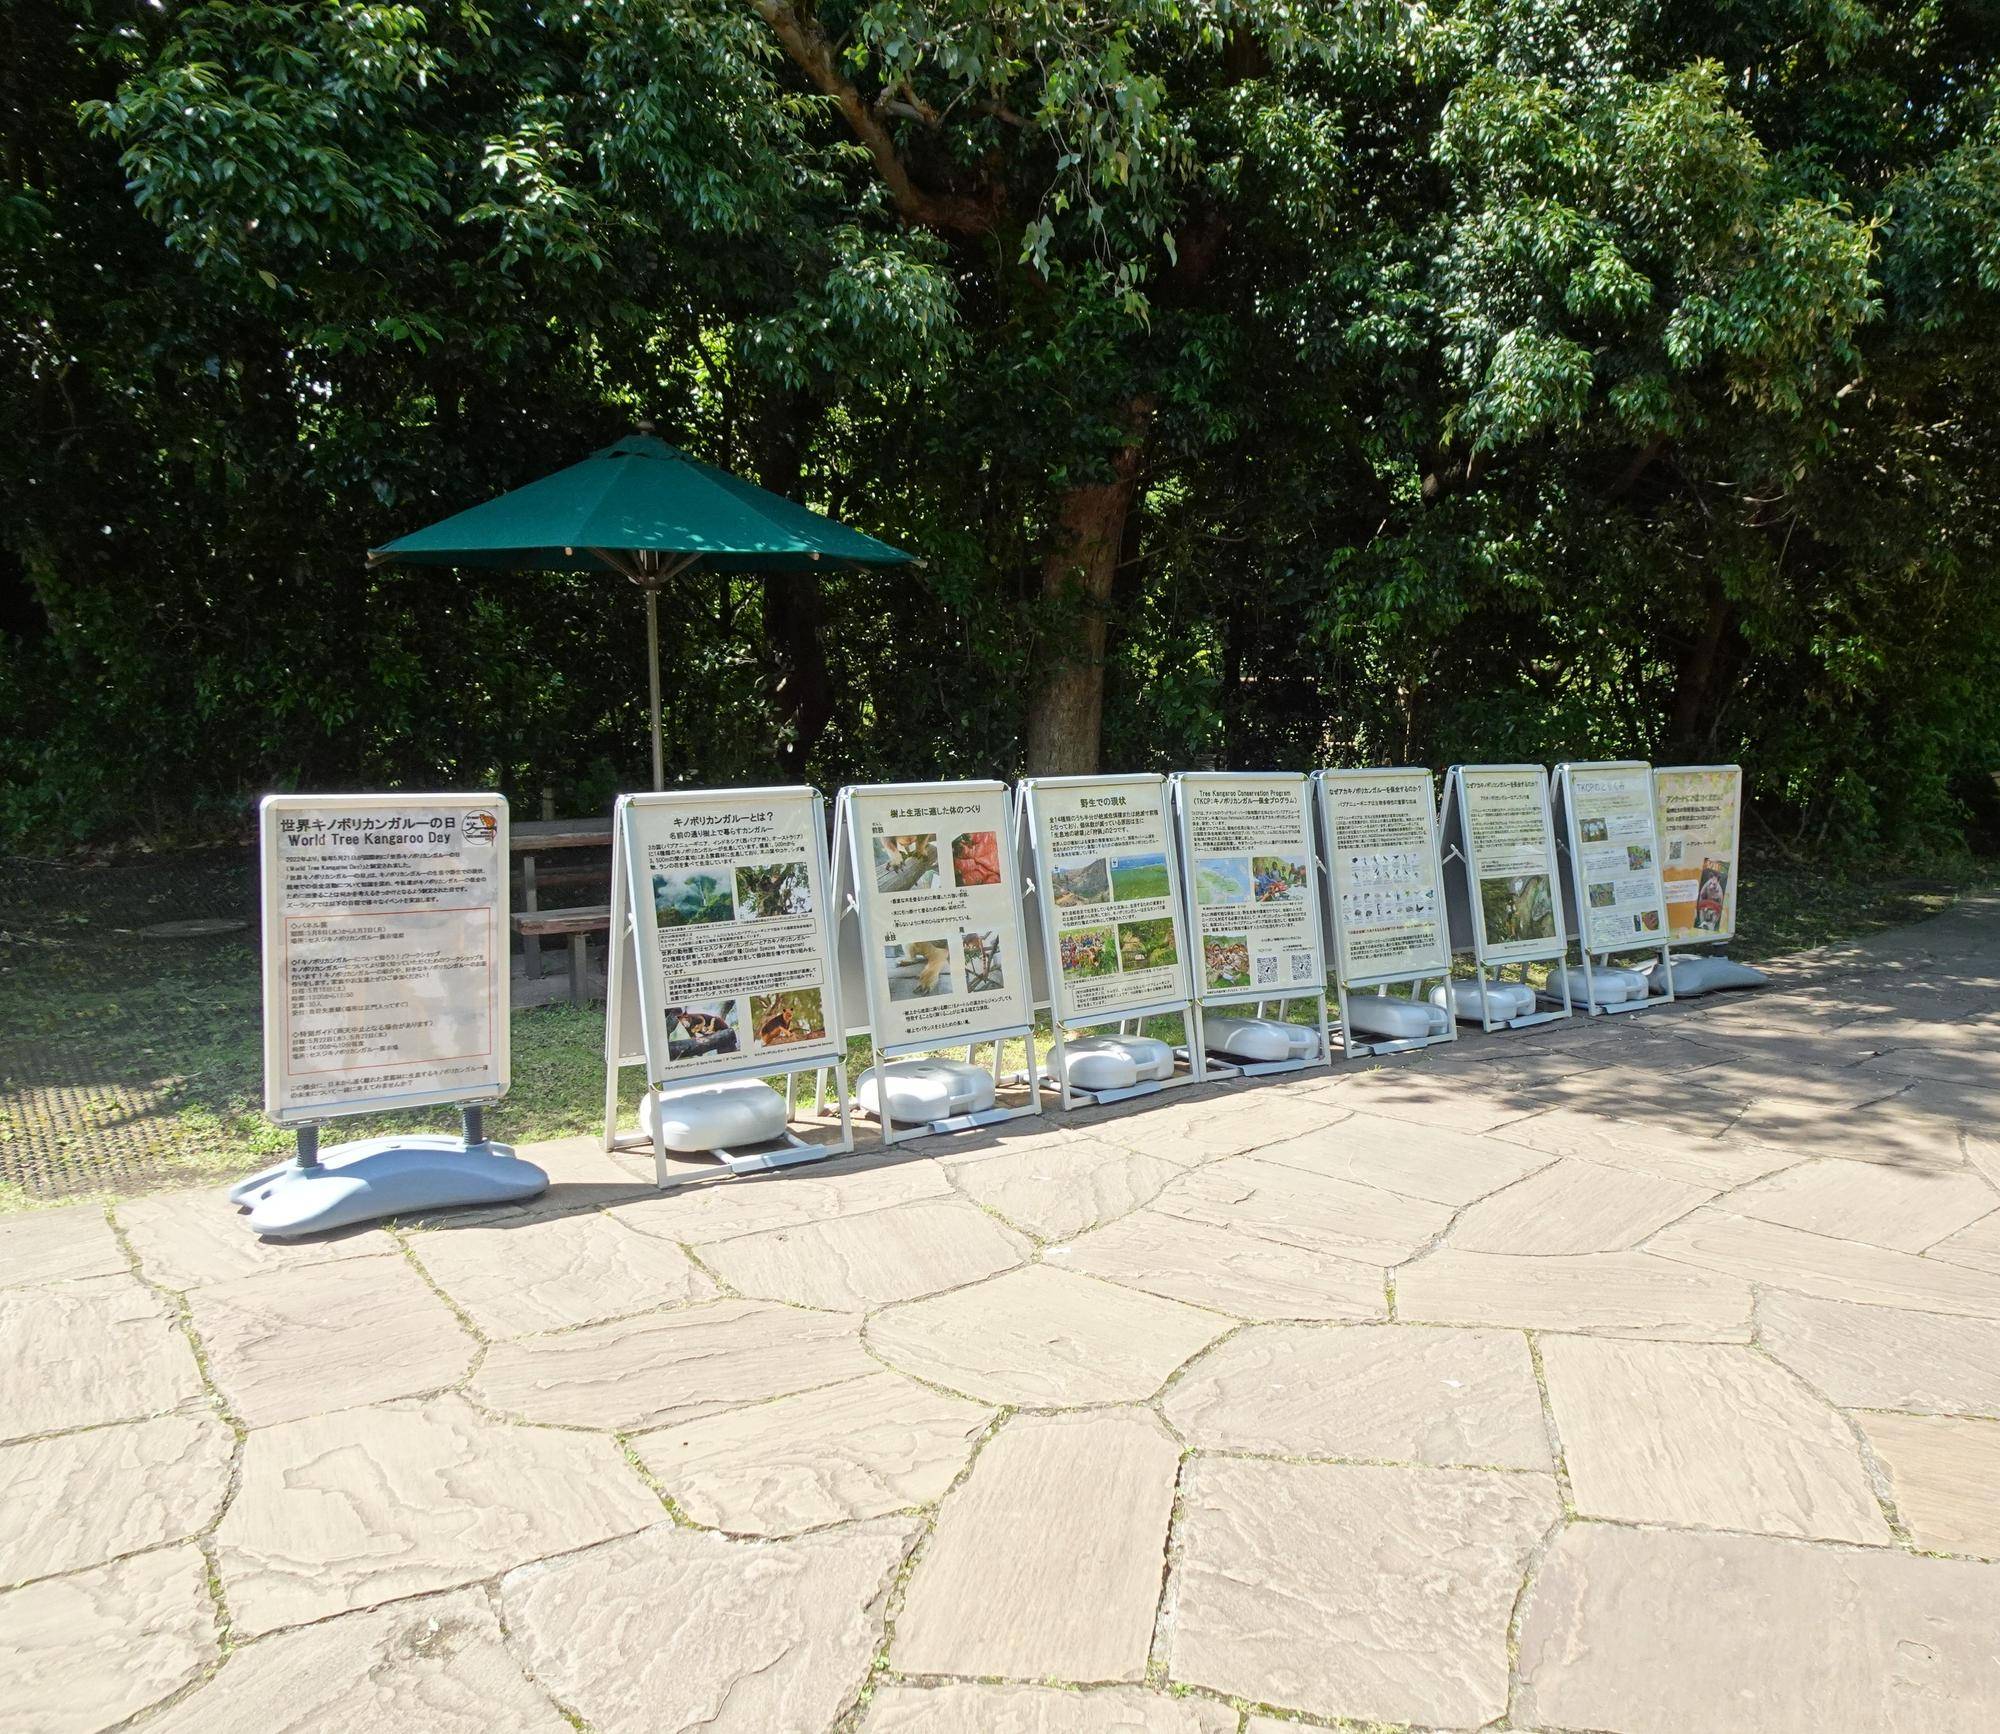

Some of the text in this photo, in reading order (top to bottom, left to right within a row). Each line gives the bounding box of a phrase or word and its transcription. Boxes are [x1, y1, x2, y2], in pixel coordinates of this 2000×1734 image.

[1212, 790, 1236, 798] Kangaroo
[1237, 789, 1270, 797] Conservation
[1270, 789, 1291, 797] Program
[1079, 796, 1128, 809] 野生での現状
[890, 804, 982, 819] 樹上生活に適した体のつくり
[281, 816, 456, 832] 世界キノボリカンガルーの日
[673, 811, 774, 828] キノボリカンガルーとは？
[289, 833, 326, 847] World
[332, 832, 359, 845] Tree
[365, 832, 424, 847] Kangaroo
[428, 831, 451, 845] Day
[669, 826, 775, 840] 名前の通り樹上で暮らすカンガルー
